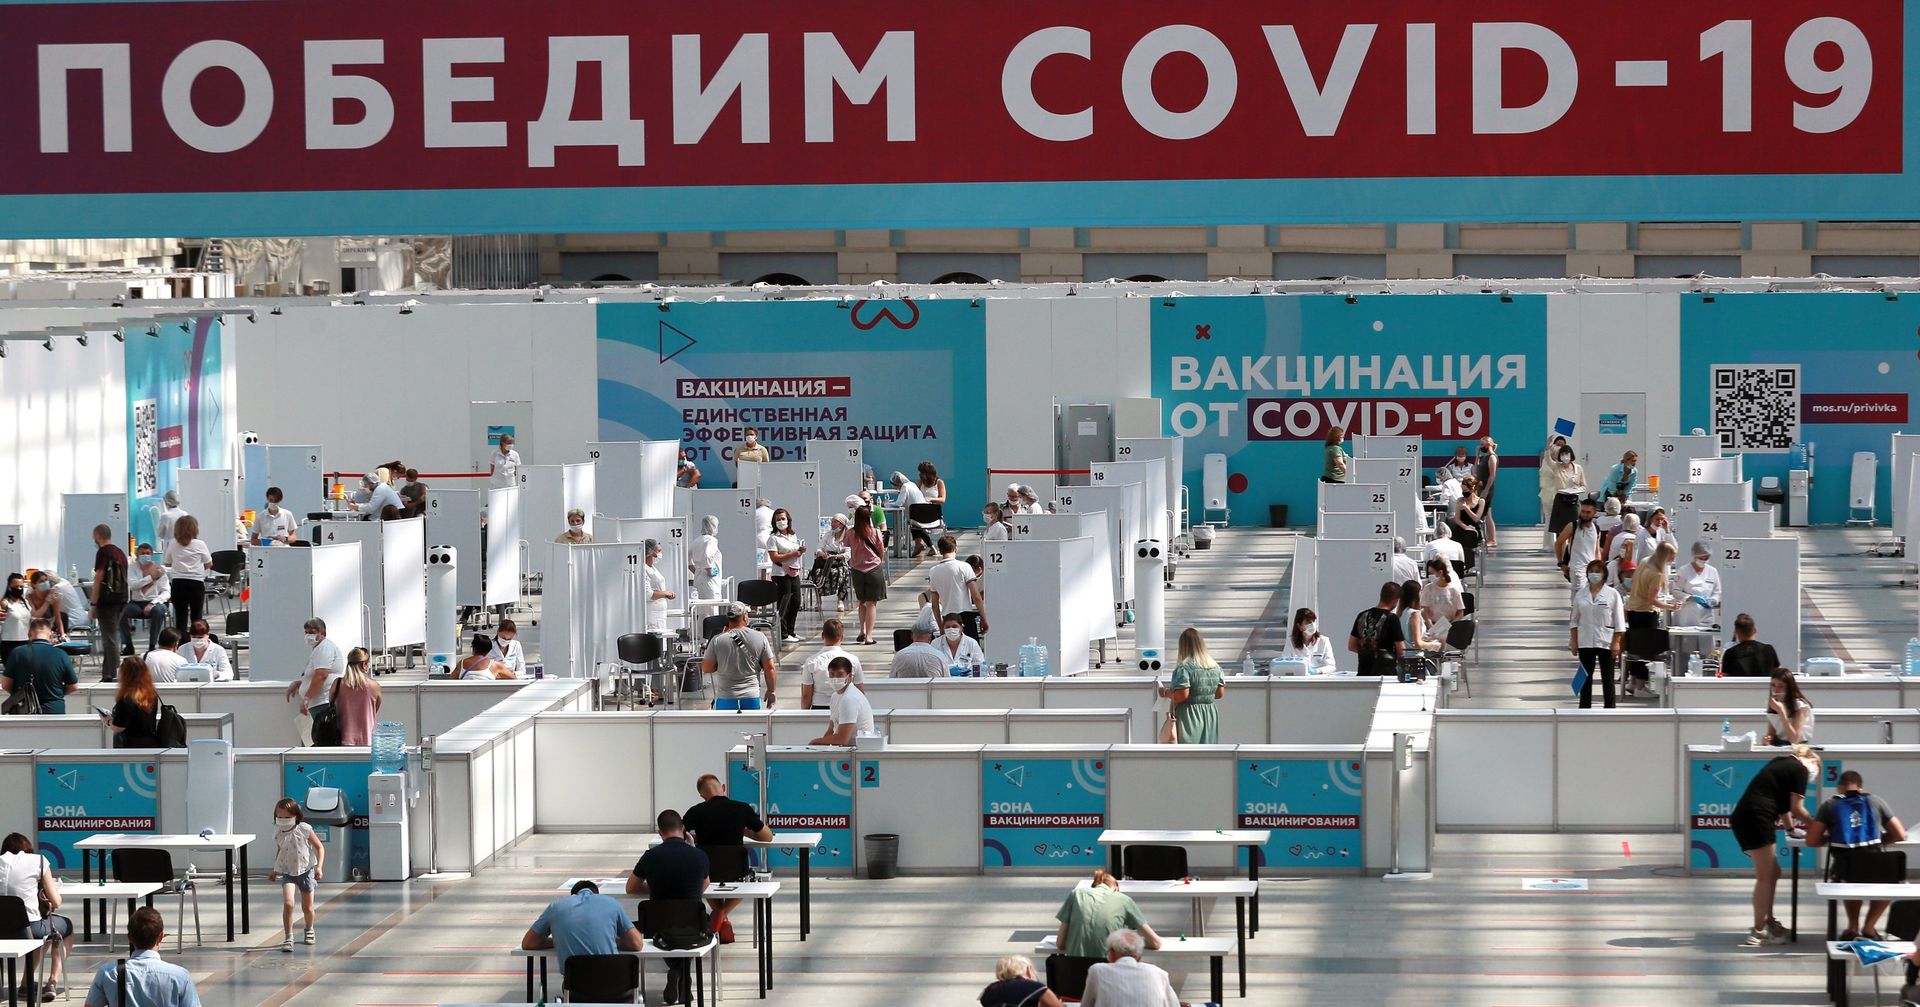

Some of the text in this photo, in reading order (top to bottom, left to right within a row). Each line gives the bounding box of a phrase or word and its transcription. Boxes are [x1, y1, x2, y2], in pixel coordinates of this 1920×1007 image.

[38, 17, 1872, 167] ПОБЕДИМ COVID-19
[1171, 355, 1527, 396] ВАКЦИНАЦИЯ
[682, 380, 827, 398] ВАКЦИНАЦИЯ
[1812, 403, 1897, 414] mos.ru/privivka
[682, 407, 848, 426] ЕДИНСТВЕННАЯ
[1171, 401, 1483, 438] ОТ COVID-19
[682, 425, 937, 442] ЭФФЕТИВНАЯ ЗАЩИТА
[848, 449, 859, 457] 19
[1119, 447, 1130, 455] 20
[1407, 445, 1417, 453] 29
[1662, 445, 1673, 453] 30
[589, 451, 600, 459] 10
[685, 447, 709, 461] ОТ
[804, 472, 815, 480] 17
[1400, 469, 1411, 477] 27
[1691, 468, 1702, 476] 28
[521, 475, 527, 483] 8
[1094, 473, 1104, 481] 18
[223, 479, 229, 487] 7
[1061, 496, 1072, 505] 16
[1373, 494, 1385, 502] 25
[1680, 494, 1693, 502] 26
[114, 504, 120, 512] 5
[432, 500, 438, 508] 6
[740, 499, 751, 508] 15
[1017, 525, 1029, 534] 14
[1376, 525, 1389, 534] 23
[1703, 522, 1717, 532] 24
[328, 532, 334, 541] 4
[671, 529, 682, 538] 13
[8, 536, 15, 545] 3
[990, 553, 1003, 563] 12
[1375, 552, 1386, 562] 21
[1726, 550, 1740, 560] 22
[257, 559, 264, 568] 2
[627, 555, 637, 565] 11
[864, 767, 876, 781] 2
[1826, 766, 1838, 781] 3
[43, 806, 87, 817] ЗОНА
[990, 802, 1034, 814] ЗОНА
[1244, 803, 1289, 814] ЗОНА
[1698, 803, 1736, 815] ЗОН
[44, 819, 152, 830] ВАКЦИНИРОВАНИЯ
[768, 816, 847, 826] ИНИРОВАНИЯ
[990, 816, 1100, 827] ВАКЦИНИРОВАНИЯ
[1244, 816, 1356, 827] ВАКЦИНИРОВАНИЯ
